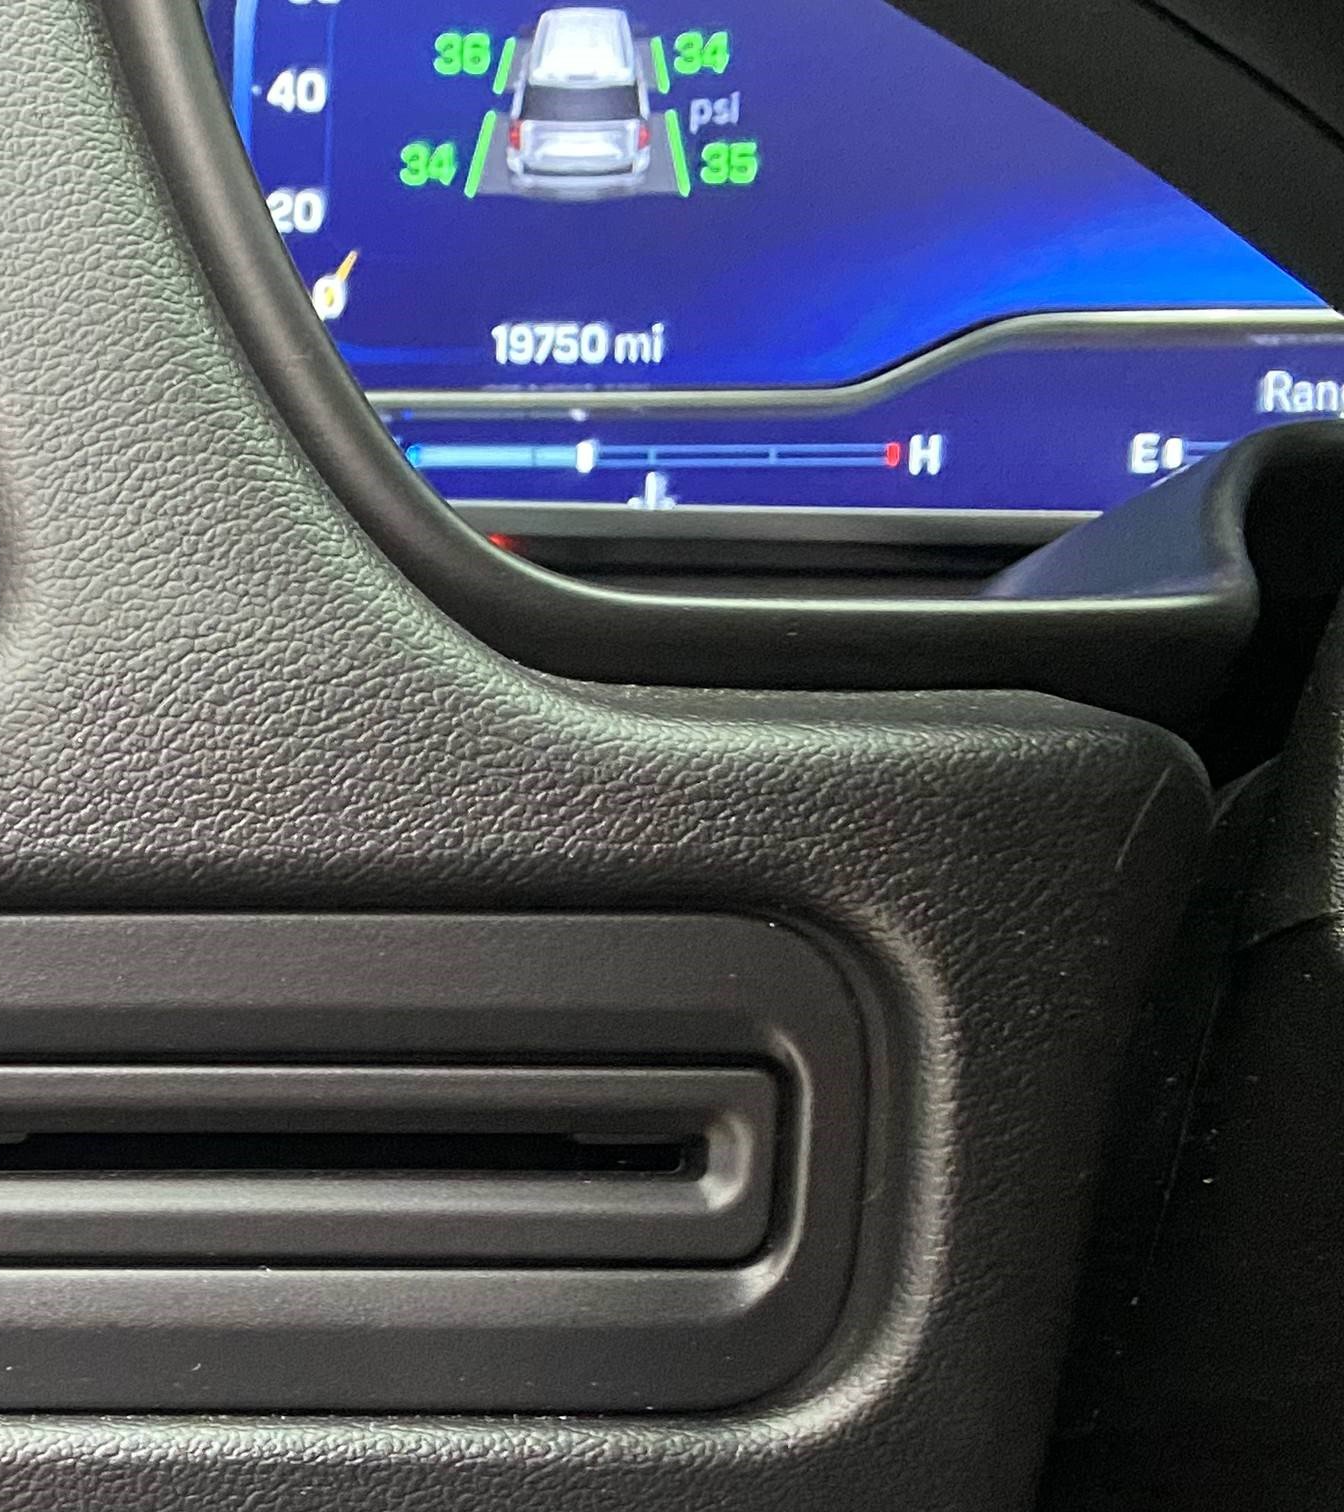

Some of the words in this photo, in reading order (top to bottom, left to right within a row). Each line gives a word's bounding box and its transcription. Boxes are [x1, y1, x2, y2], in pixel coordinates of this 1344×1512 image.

[433, 32, 491, 75] 36
[673, 32, 729, 74] 34
[266, 69, 327, 113] 40
[689, 92, 741, 135] psi
[400, 142, 457, 186] 34
[700, 142, 758, 184] 35
[266, 188, 325, 233] 20
[313, 275, 346, 320] 0
[491, 322, 609, 365] 19750
[614, 322, 665, 364] mi
[909, 433, 944, 476] H
[1129, 432, 1161, 474] E
